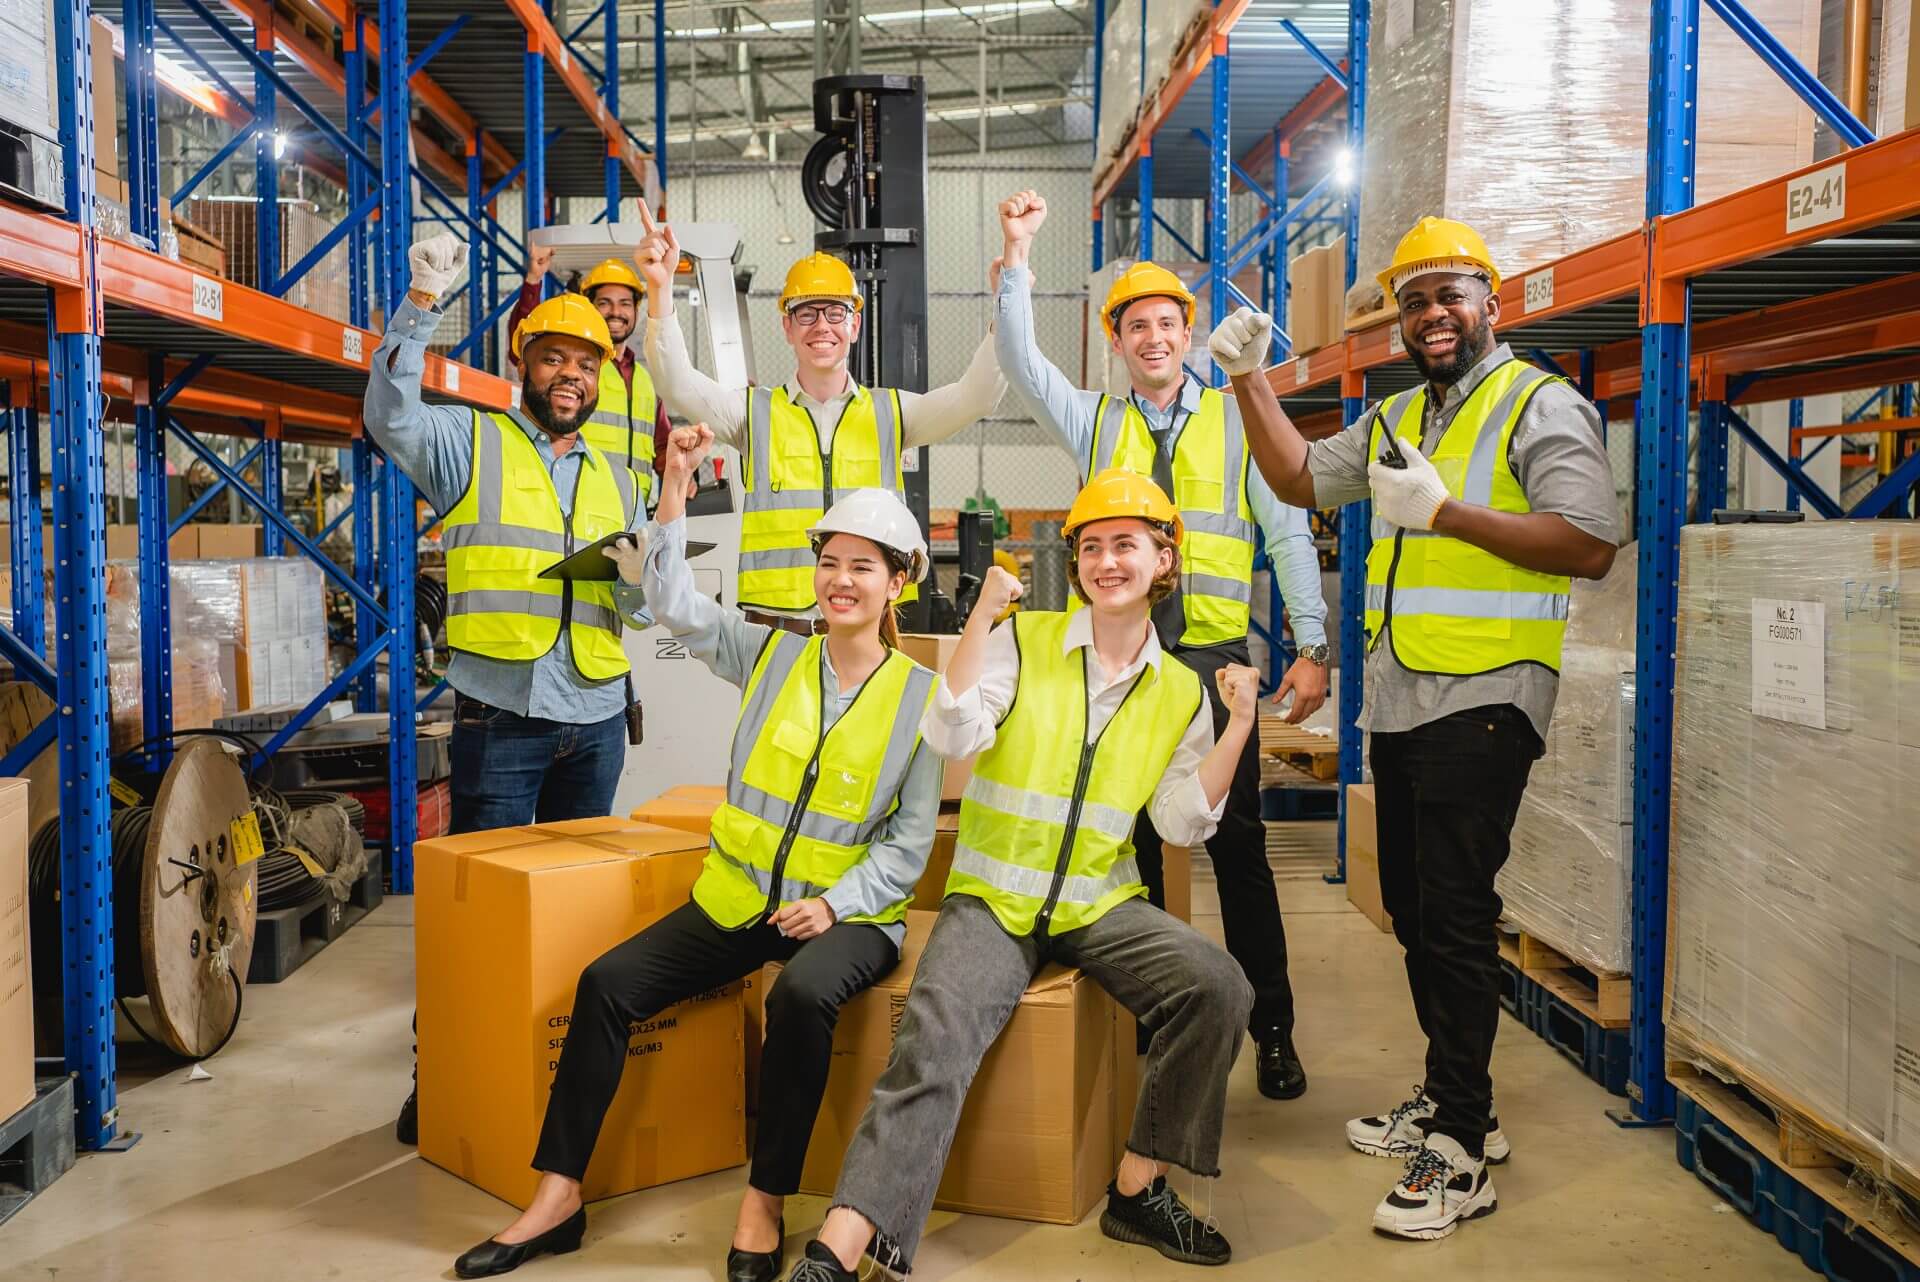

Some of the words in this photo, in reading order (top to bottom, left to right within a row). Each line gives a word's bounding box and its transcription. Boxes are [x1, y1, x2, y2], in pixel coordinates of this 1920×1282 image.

[1790, 176, 1842, 220] E2-41
[194, 283, 221, 312] D2-51
[1526, 276, 1553, 304] E2-52
[1789, 608, 1795, 621] 2
[548, 1015, 570, 1028] CER
[548, 1036, 568, 1049] SIZ
[630, 1022, 656, 1035] 0X25
[658, 1017, 677, 1030] MM
[628, 1041, 663, 1057] KG/M3
